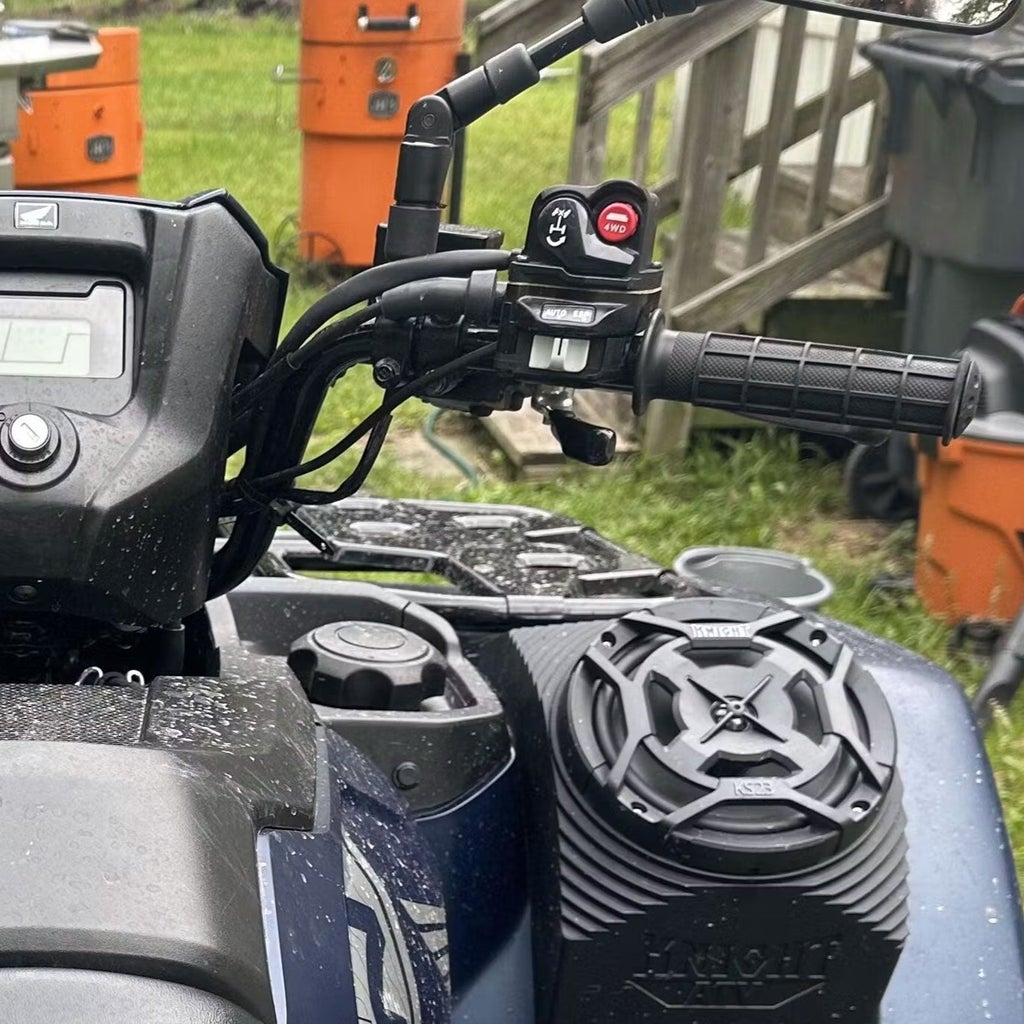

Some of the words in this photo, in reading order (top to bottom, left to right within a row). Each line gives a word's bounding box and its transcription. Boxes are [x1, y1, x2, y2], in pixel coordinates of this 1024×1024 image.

[604, 223, 627, 234] 4WD
[544, 308, 567, 318] AUTO
[690, 623, 752, 638] KNIGHT
[733, 781, 775, 797] KS23
